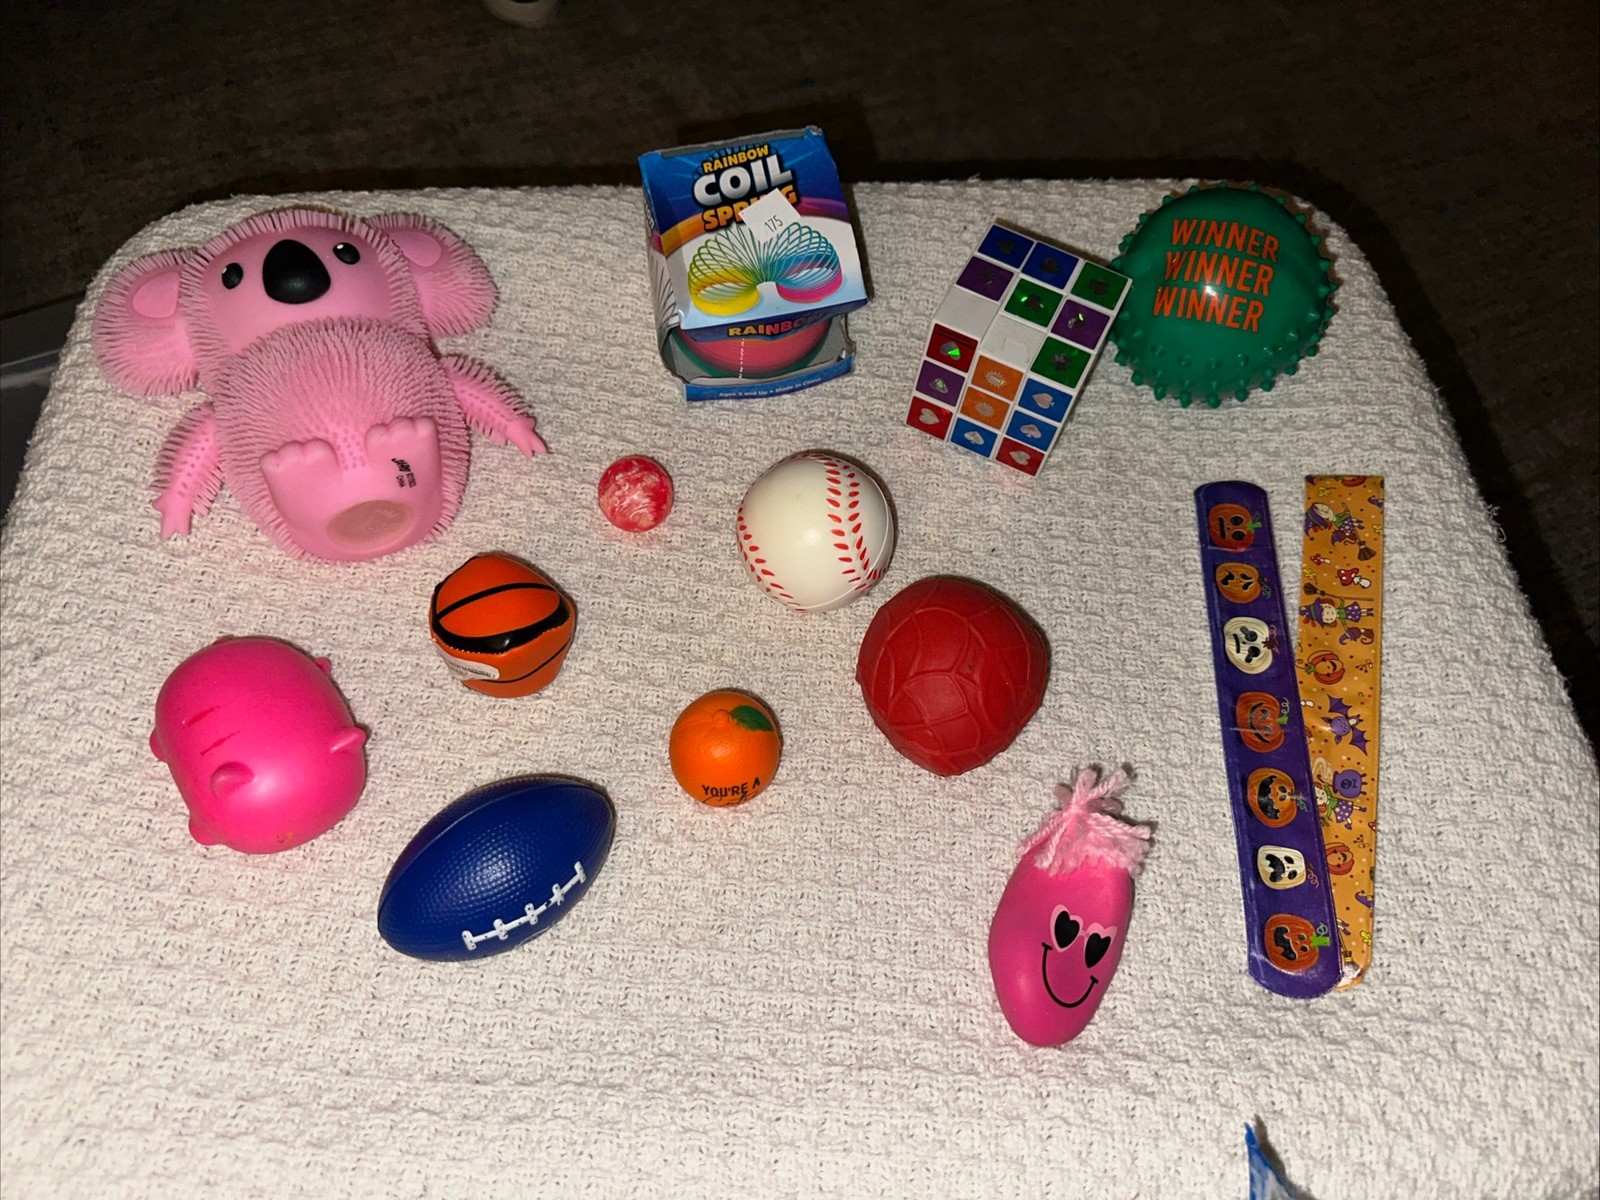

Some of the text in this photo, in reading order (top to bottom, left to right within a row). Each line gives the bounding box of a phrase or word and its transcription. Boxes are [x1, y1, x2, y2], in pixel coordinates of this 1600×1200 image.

[693, 154, 793, 206] COIL
[703, 145, 769, 173] RAINBOW
[703, 185, 797, 230] SPRG
[764, 215, 784, 232] 175
[1172, 219, 1279, 262] WINNER
[1165, 250, 1274, 297] WINNER
[1153, 286, 1264, 332] WINNER
[701, 782, 749, 798] YOU'RE
[752, 777, 761, 790] A
